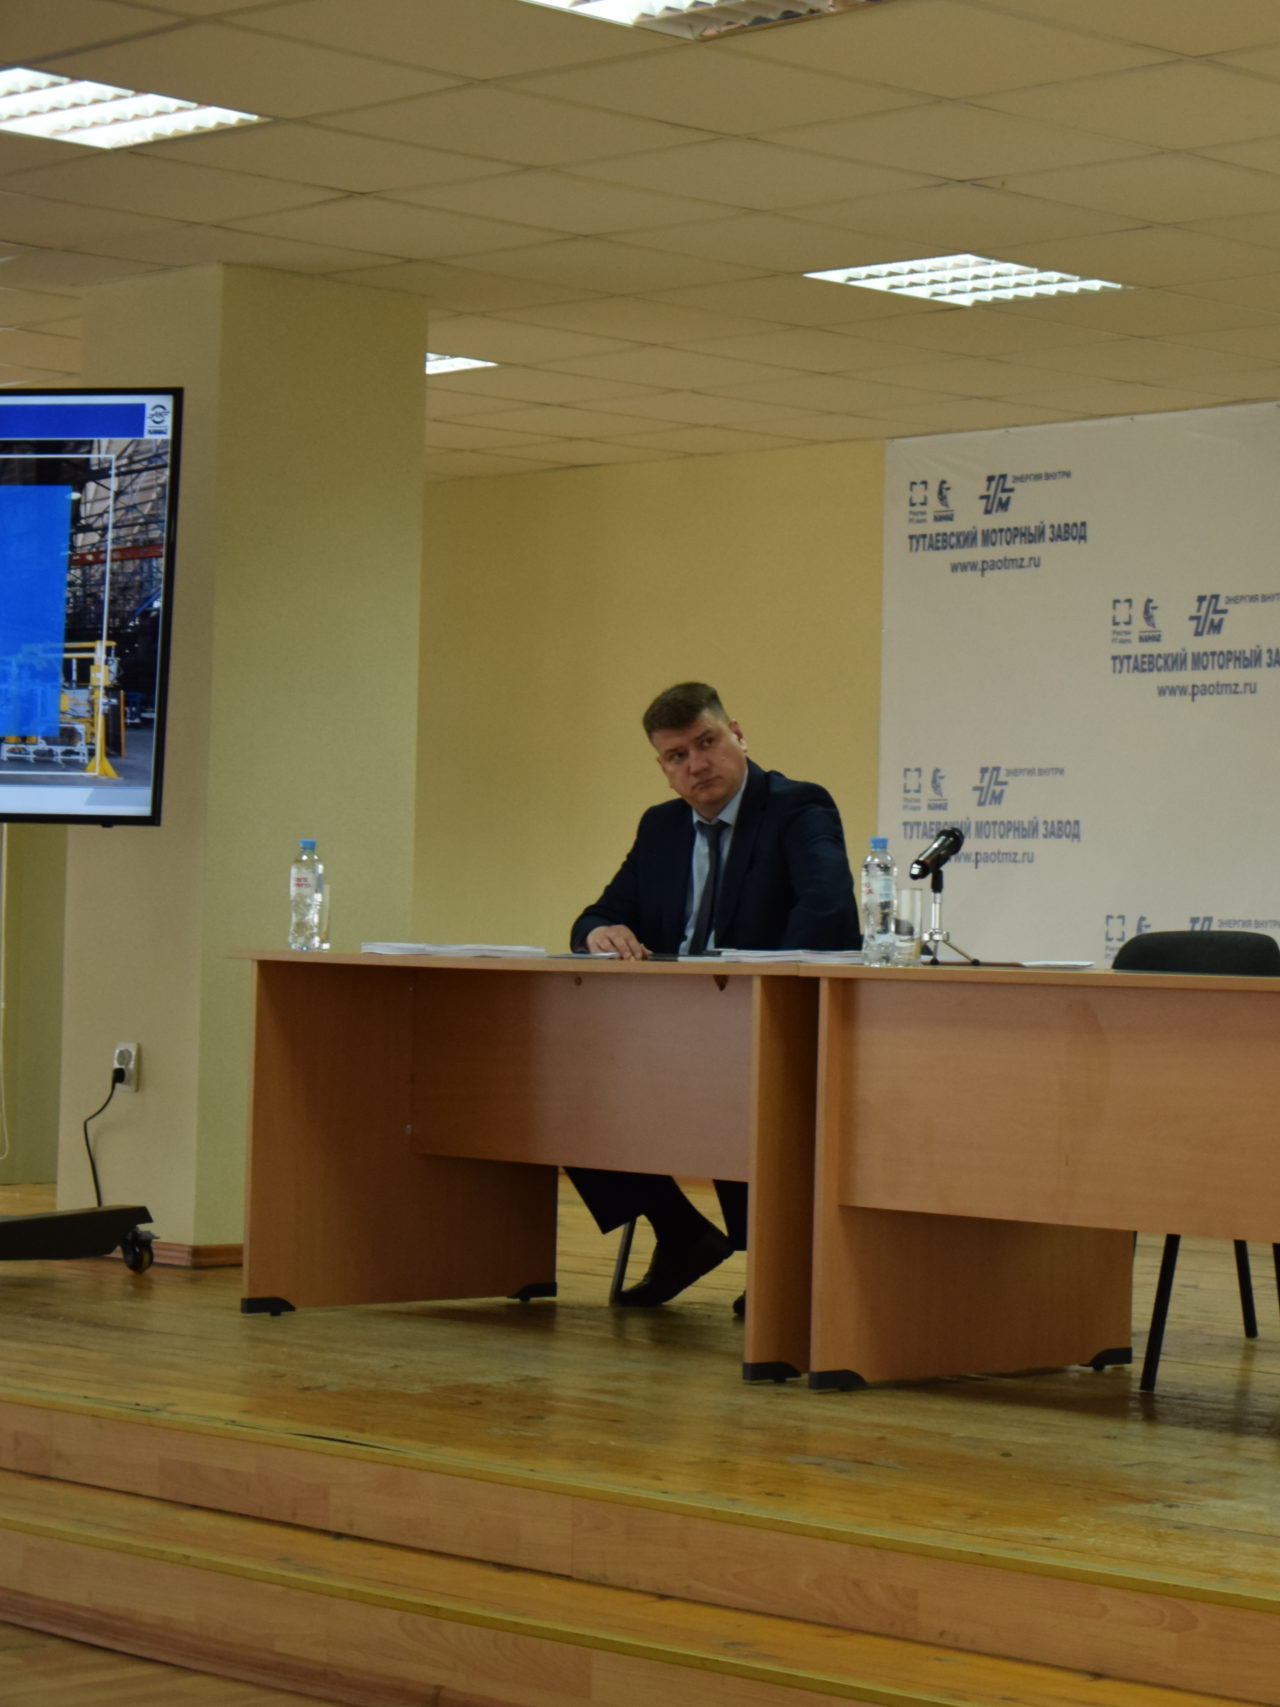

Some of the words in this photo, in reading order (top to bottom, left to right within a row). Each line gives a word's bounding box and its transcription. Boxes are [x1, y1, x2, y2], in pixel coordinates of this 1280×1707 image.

[909, 526, 977, 552] ТУТАЕВСКИЙ
[981, 521, 1045, 547] МОТОРНЫЙ
[1049, 521, 1087, 543] ЗАВОД
[951, 556, 1040, 577] www.paotmz.ru
[1111, 649, 1186, 674] ТУТАЕВСКИЙ
[1191, 645, 1262, 671] МОТОРНЫЙ
[1158, 682, 1256, 702] www.paotmz.ru
[975, 816, 1038, 840] МОТОРНЫЙ
[1042, 820, 1081, 842] ЗАВОД
